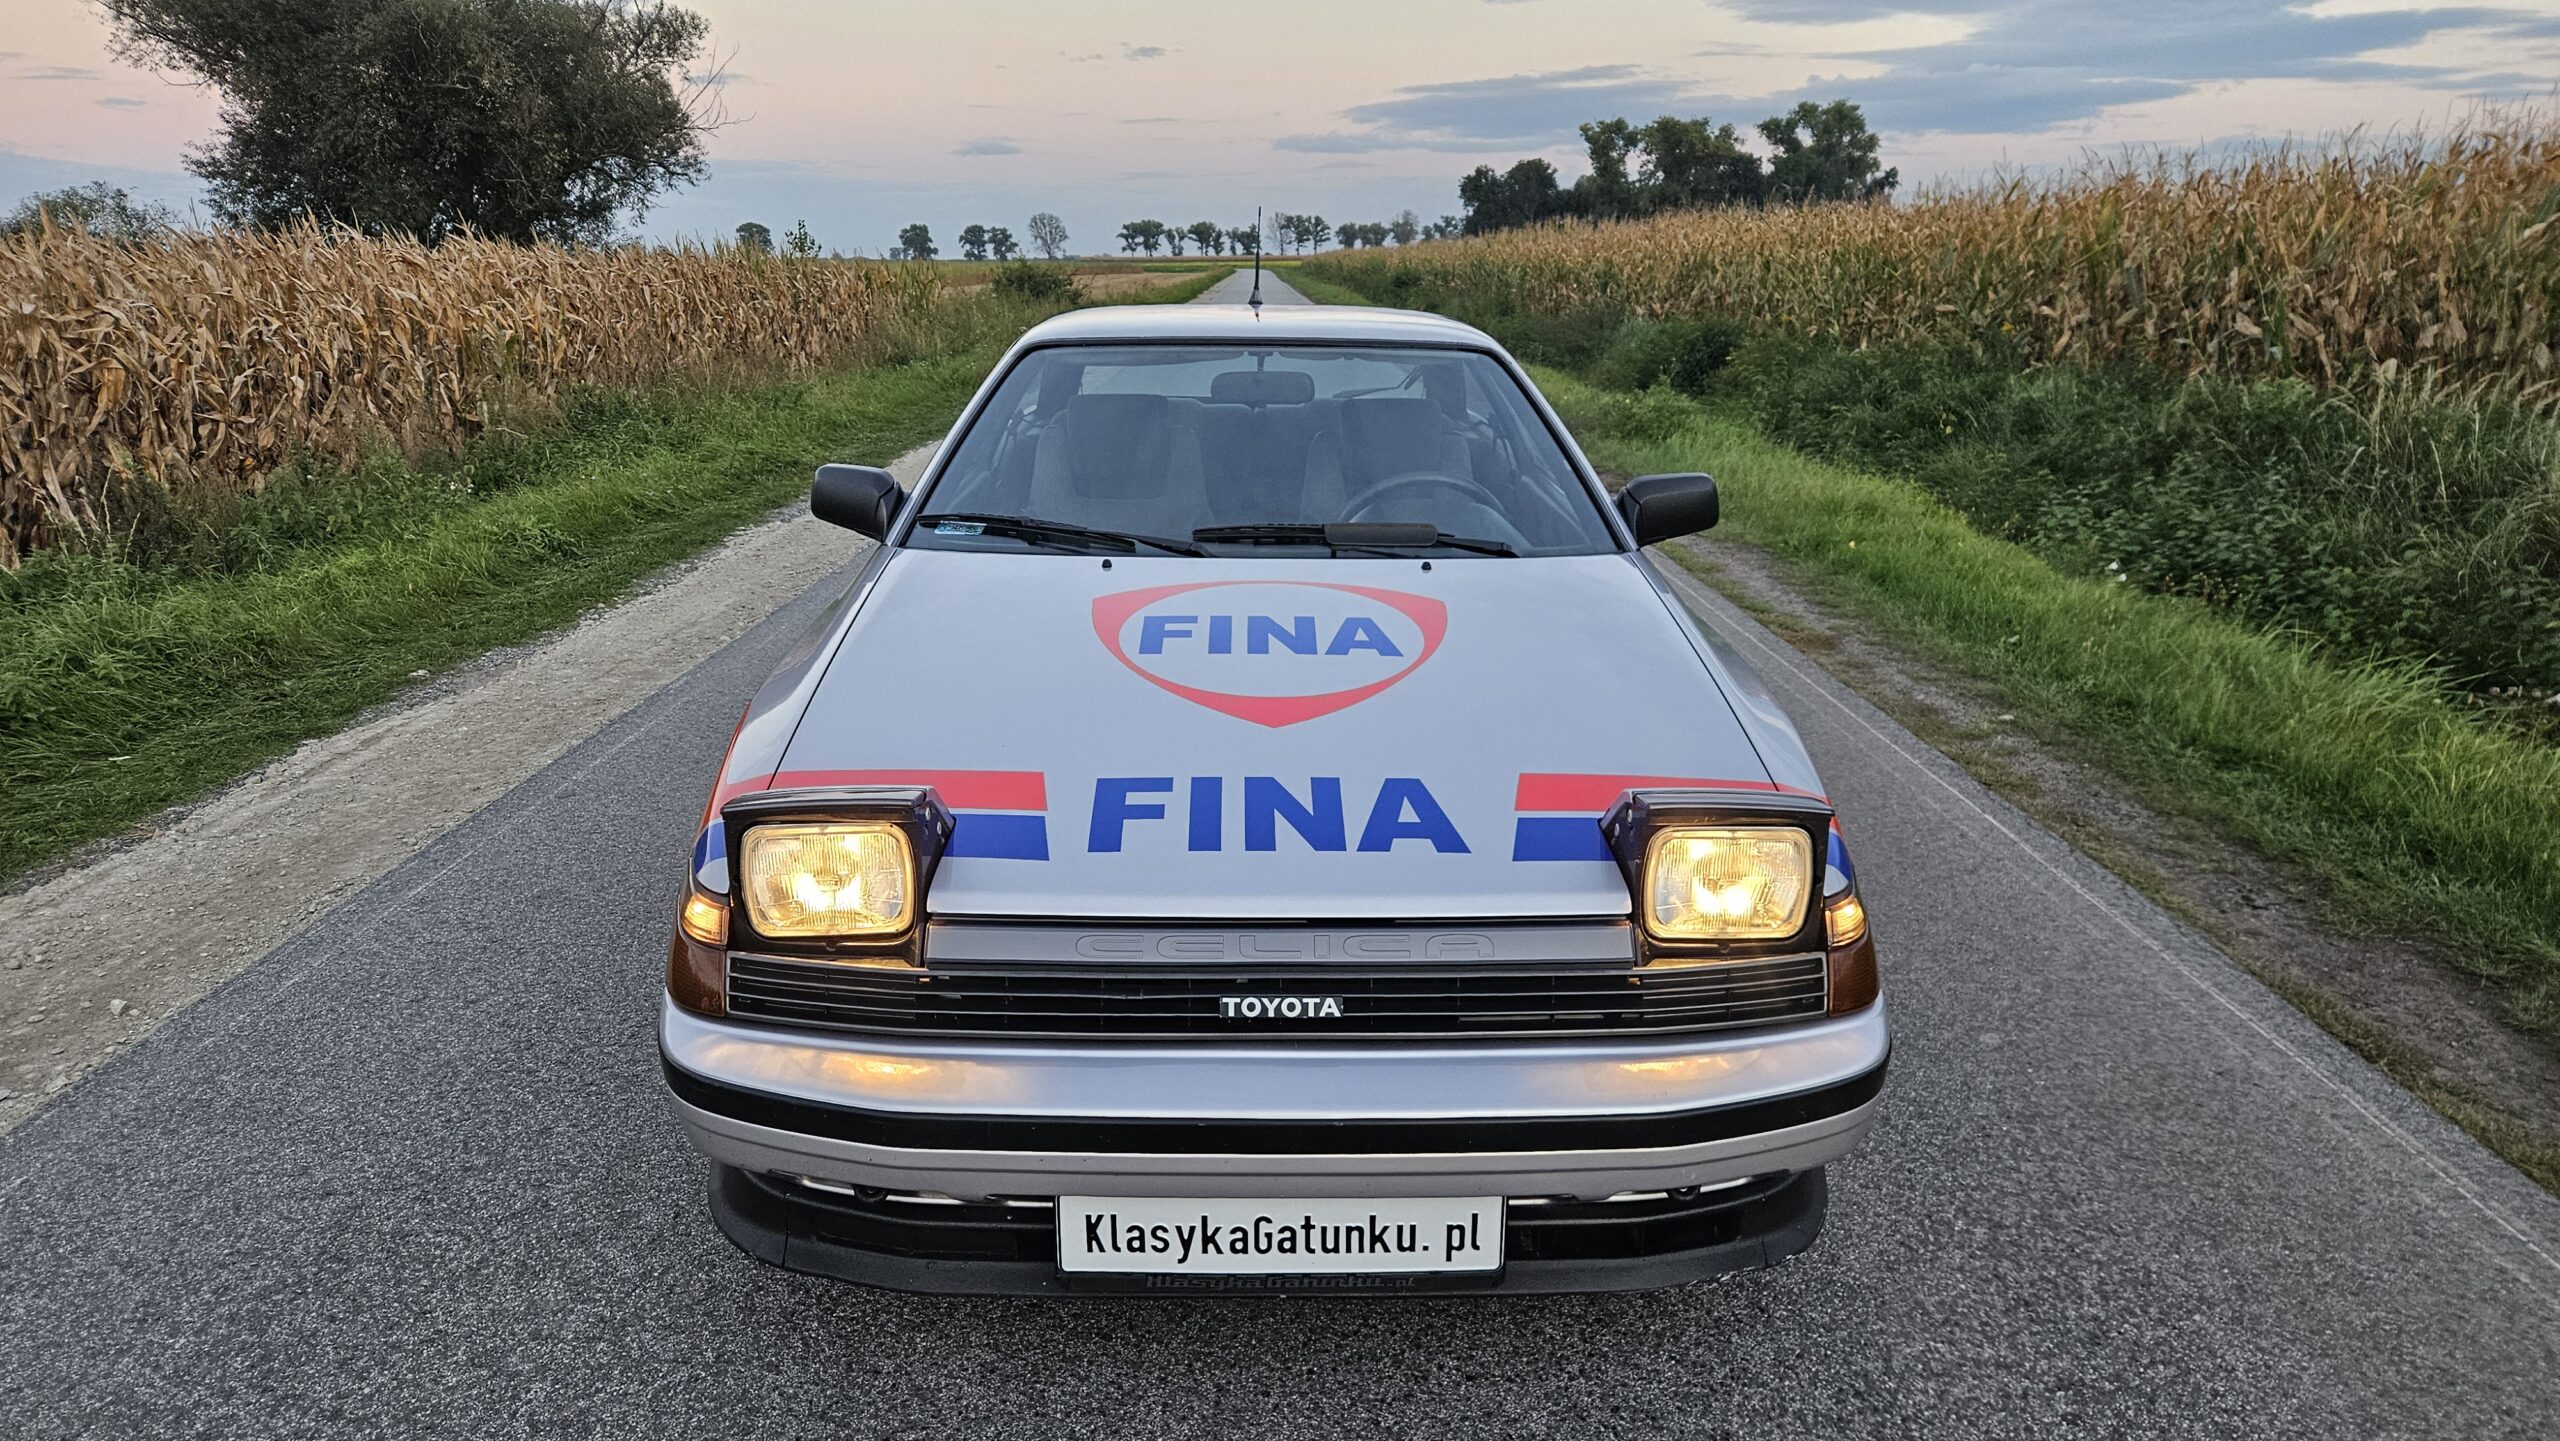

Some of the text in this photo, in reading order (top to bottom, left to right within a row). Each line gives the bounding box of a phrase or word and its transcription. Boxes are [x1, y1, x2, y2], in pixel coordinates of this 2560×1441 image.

[1138, 614, 1404, 657] FINA
[1087, 775, 1472, 856] FINA
[1075, 933, 1496, 960] CELICA
[1222, 997, 1342, 1018] TOYOTA
